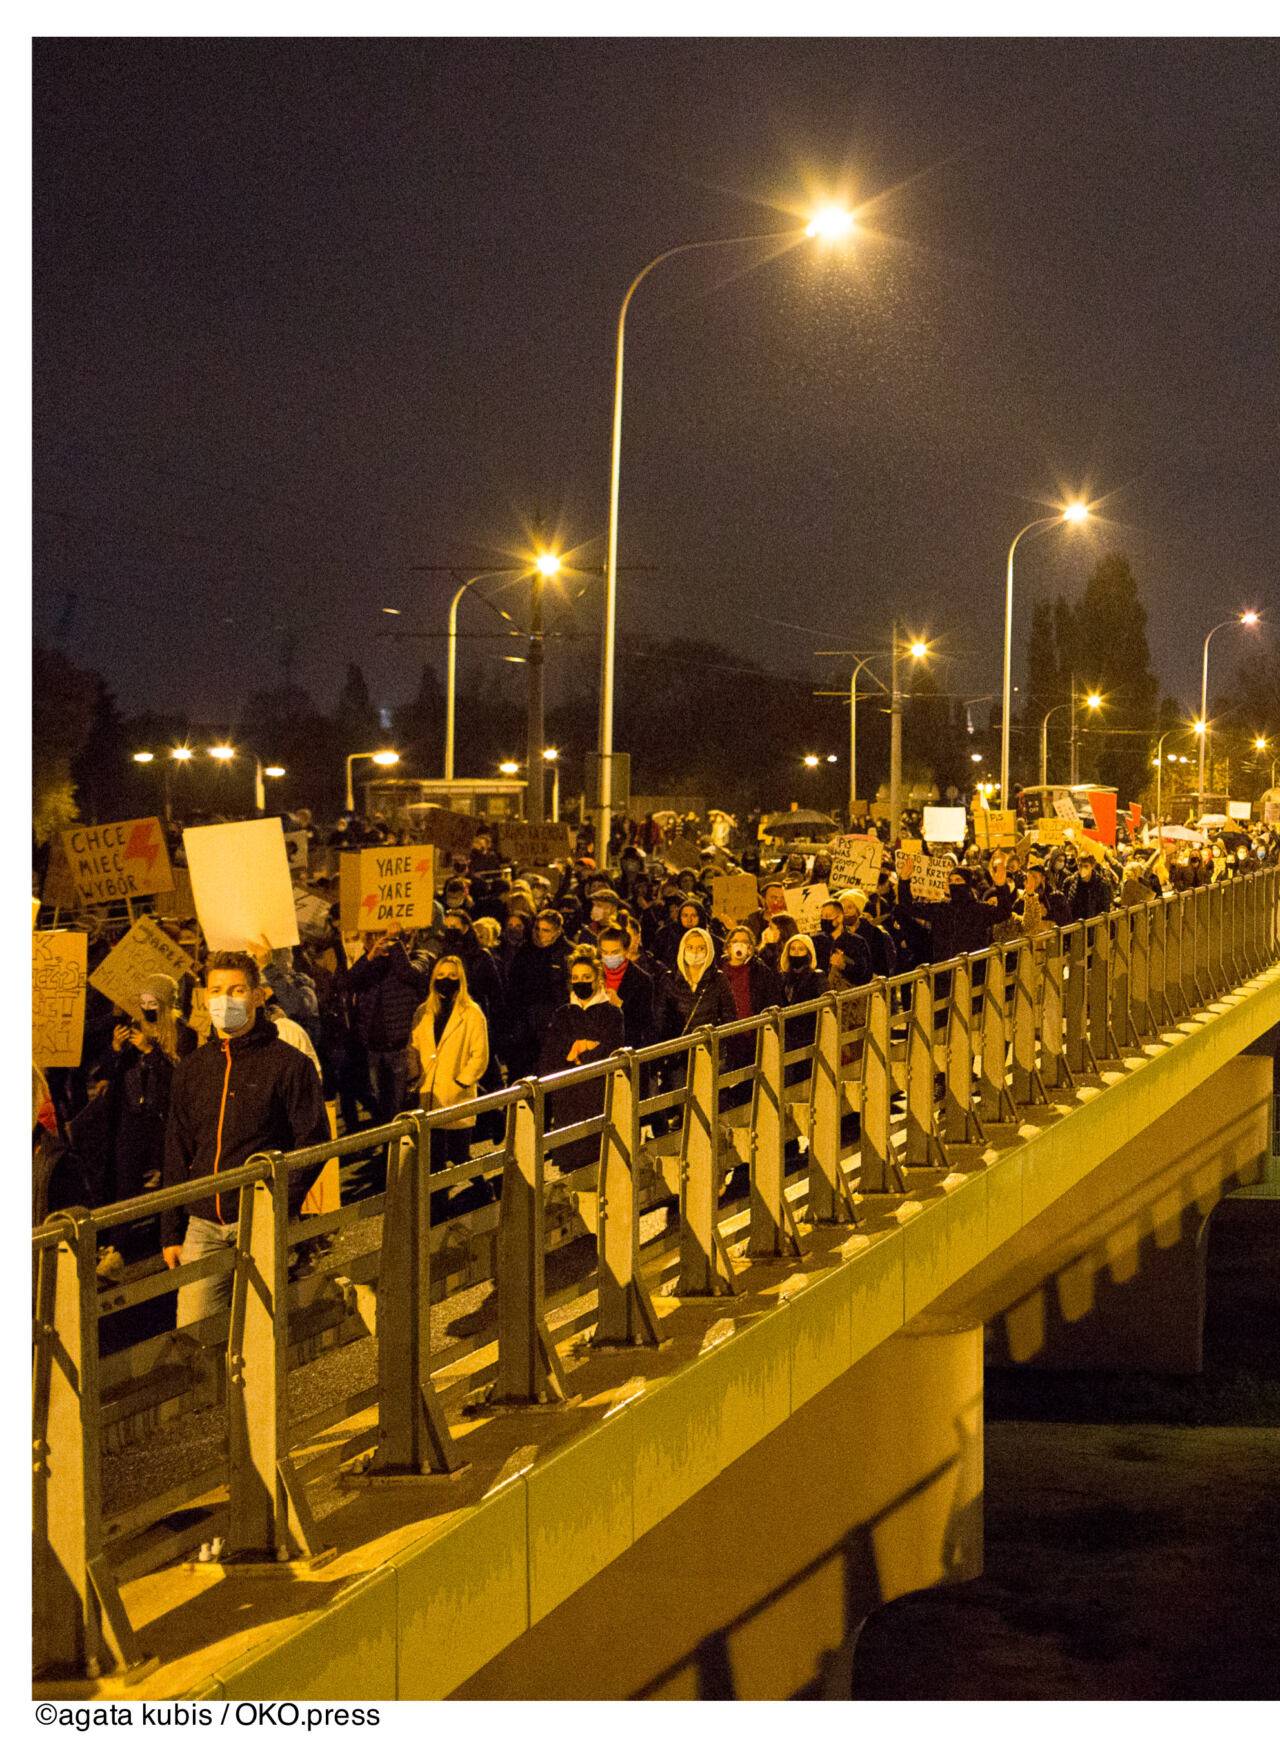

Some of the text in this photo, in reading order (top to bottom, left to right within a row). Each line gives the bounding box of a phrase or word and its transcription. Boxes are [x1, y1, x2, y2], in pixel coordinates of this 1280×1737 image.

[72, 826, 126, 853] CHCE
[376, 856, 412, 878] YARE
[377, 881, 412, 901] YARE
[377, 903, 415, 920] DAZE
